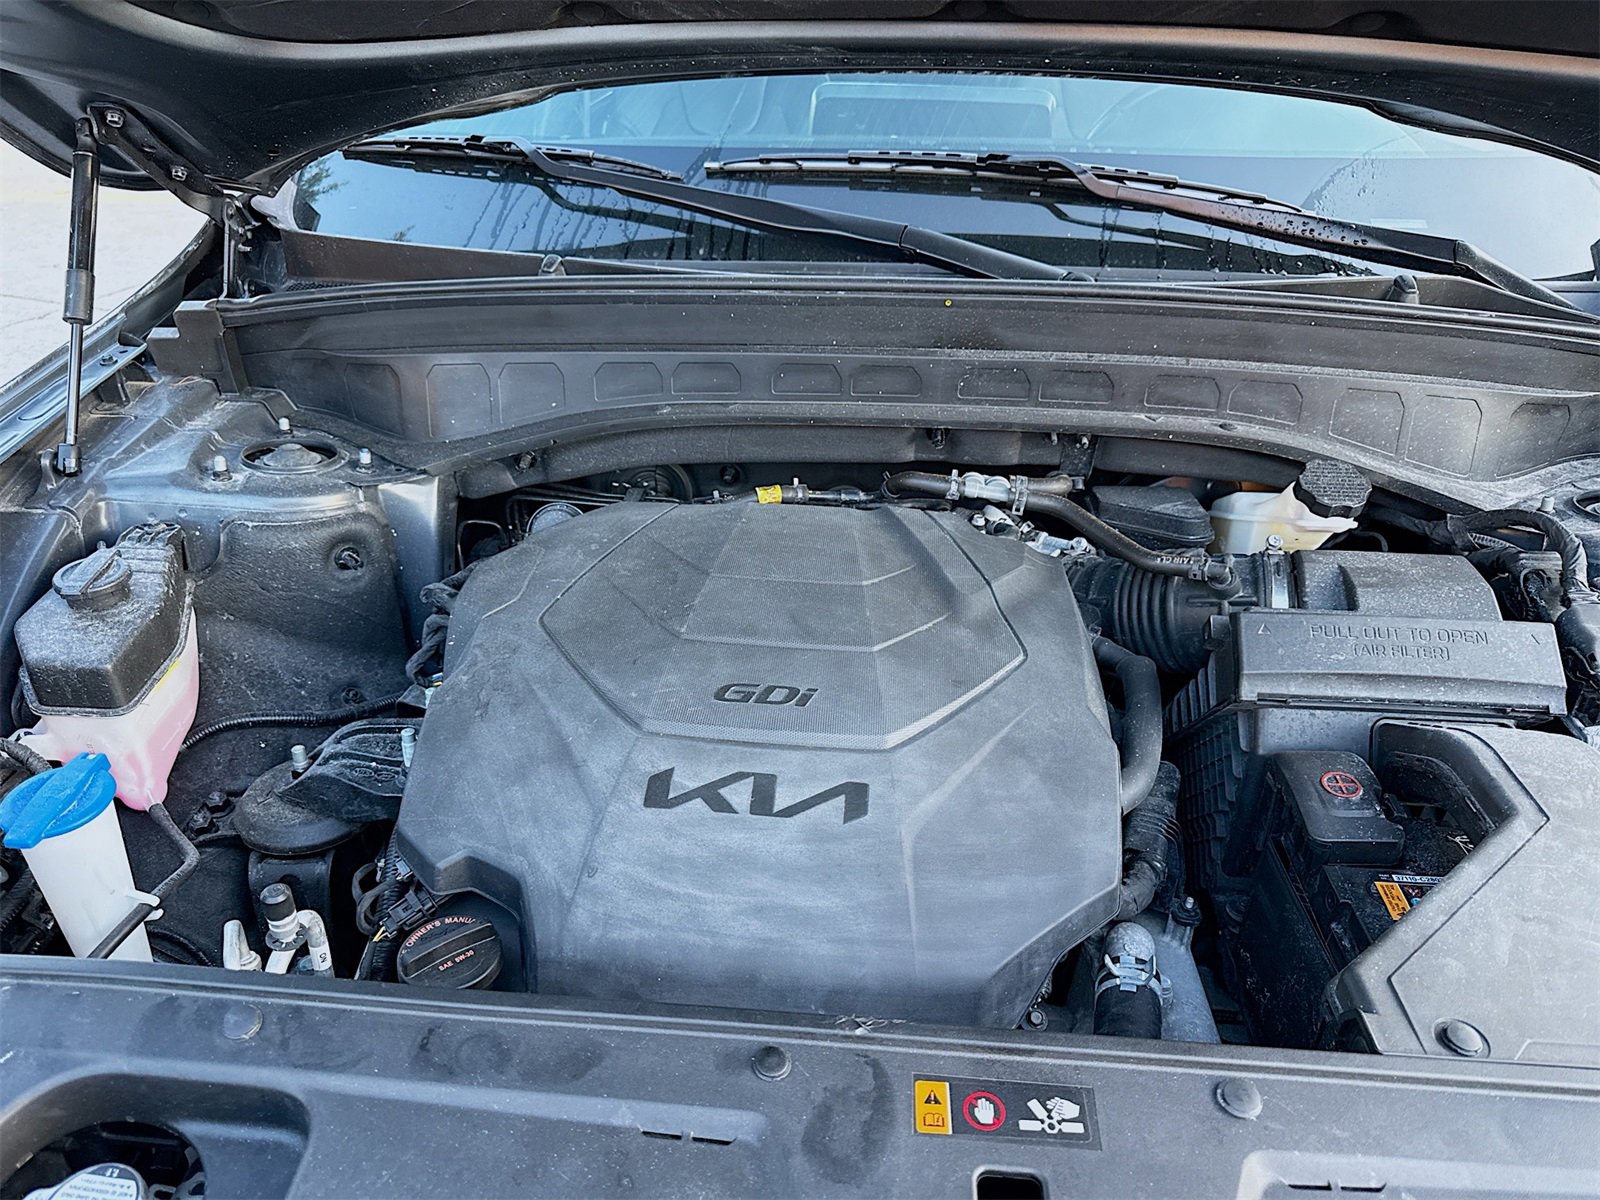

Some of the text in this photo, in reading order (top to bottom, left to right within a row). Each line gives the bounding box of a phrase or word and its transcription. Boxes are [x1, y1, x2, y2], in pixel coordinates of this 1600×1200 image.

[1310, 624, 1489, 645] PULL OUT TO OPEN
[1353, 643, 1450, 661] (AIR FILTER)
[713, 683, 819, 708] GDi
[643, 767, 870, 825] KIA
[405, 920, 441, 947] OWNER'S
[438, 949, 475, 972] SAE 5W-30
